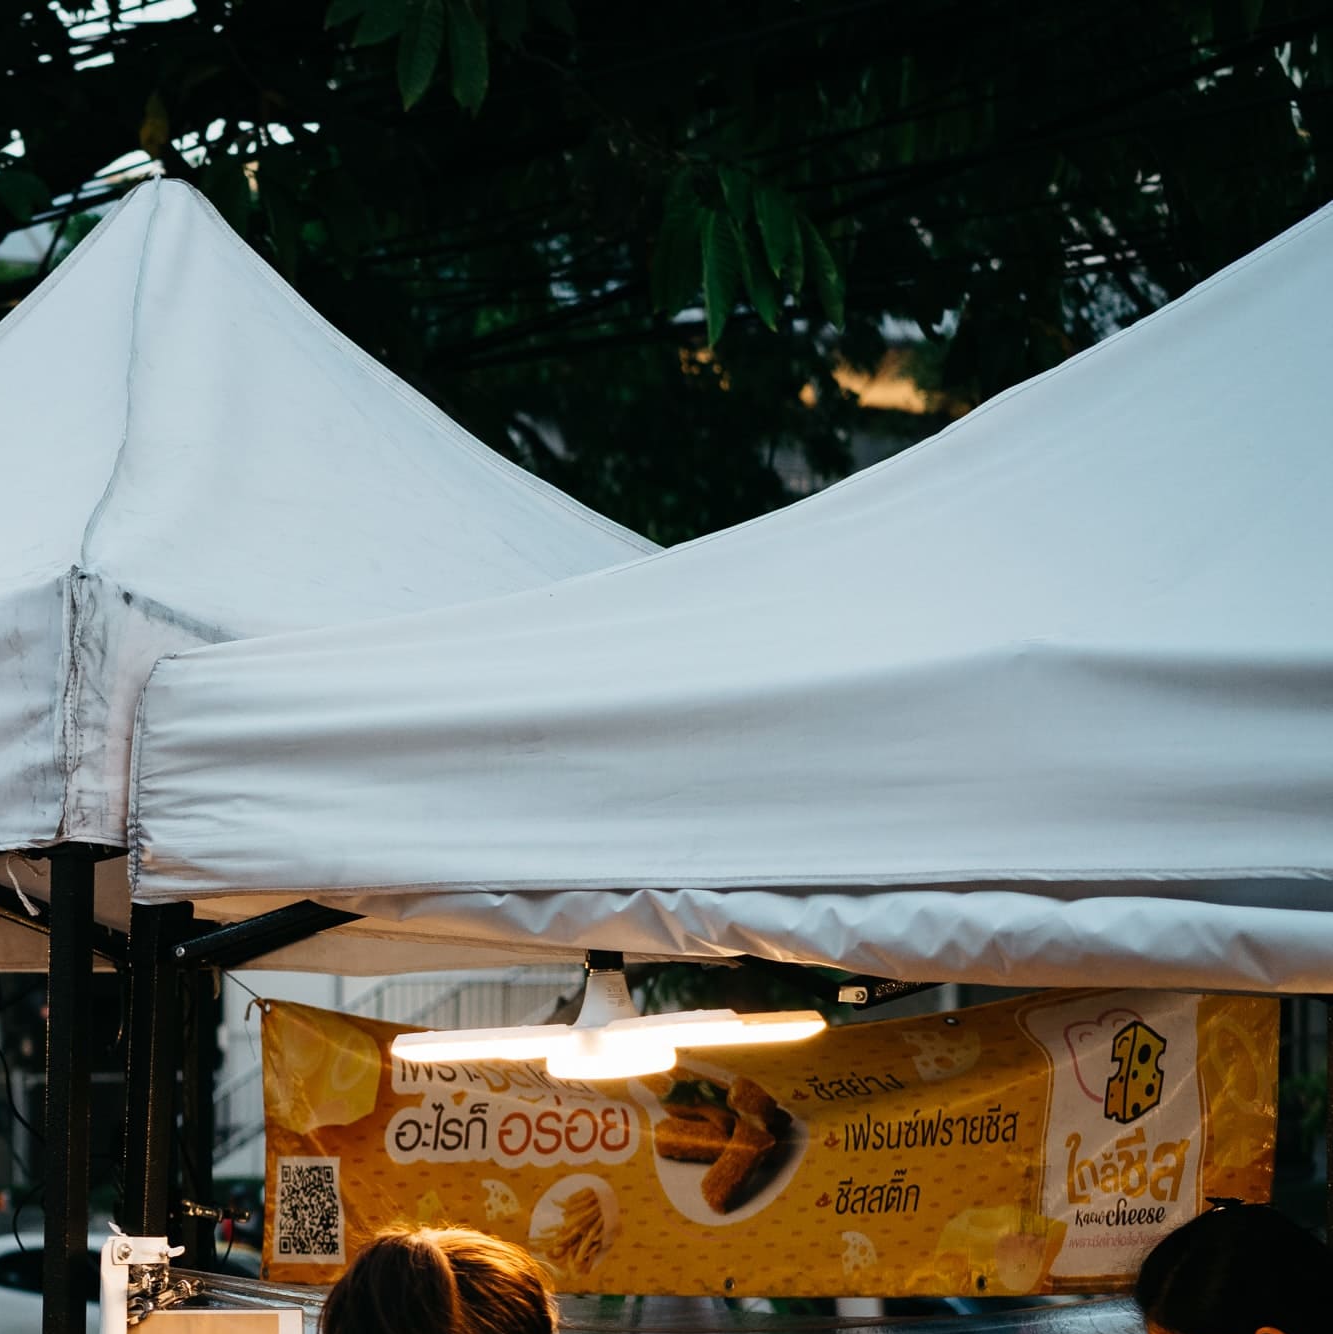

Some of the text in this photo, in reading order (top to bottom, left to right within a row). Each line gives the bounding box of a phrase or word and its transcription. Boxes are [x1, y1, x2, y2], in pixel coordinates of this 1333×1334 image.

[808, 1071, 905, 1101] ชีสย่าง
[395, 1095, 631, 1156] อะไรก็ อร่อย
[835, 1168, 920, 1216] ชีสสติ๊ก
[1065, 1127, 1191, 1205] ใกล้ชีส
